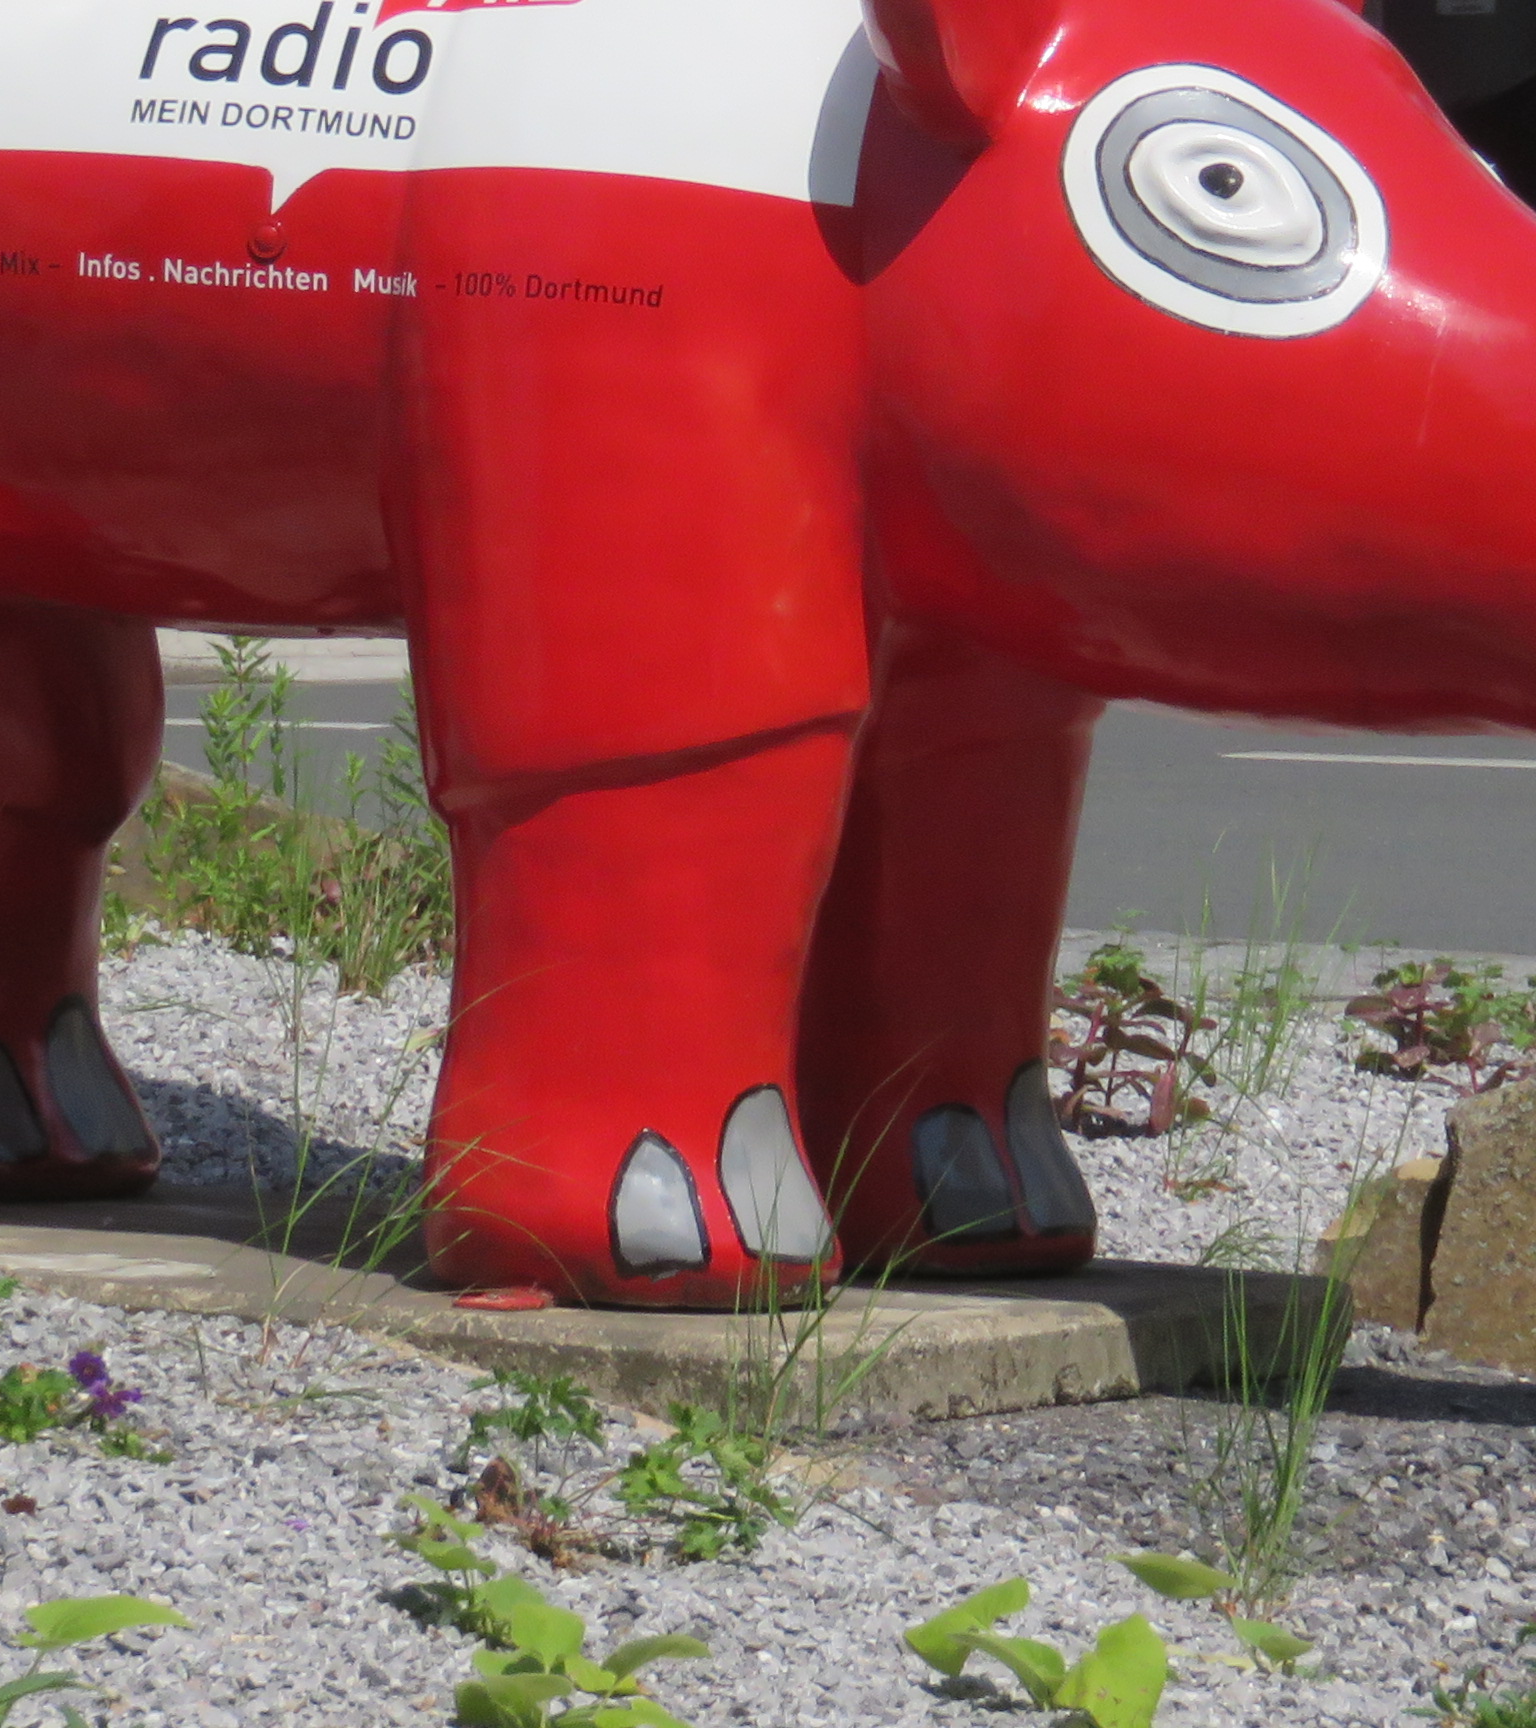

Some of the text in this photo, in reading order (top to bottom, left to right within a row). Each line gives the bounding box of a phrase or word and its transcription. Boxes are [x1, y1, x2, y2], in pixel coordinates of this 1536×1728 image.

[138, 1, 434, 95] radio
[130, 99, 417, 140] MEIN DORTMUND
[0, 250, 41, 276] Mix
[77, 251, 141, 282] Infos
[163, 258, 328, 292] Nachrichten
[353, 268, 418, 299] Musik
[454, 273, 516, 298] 100%
[525, 274, 664, 309] Dortmund
